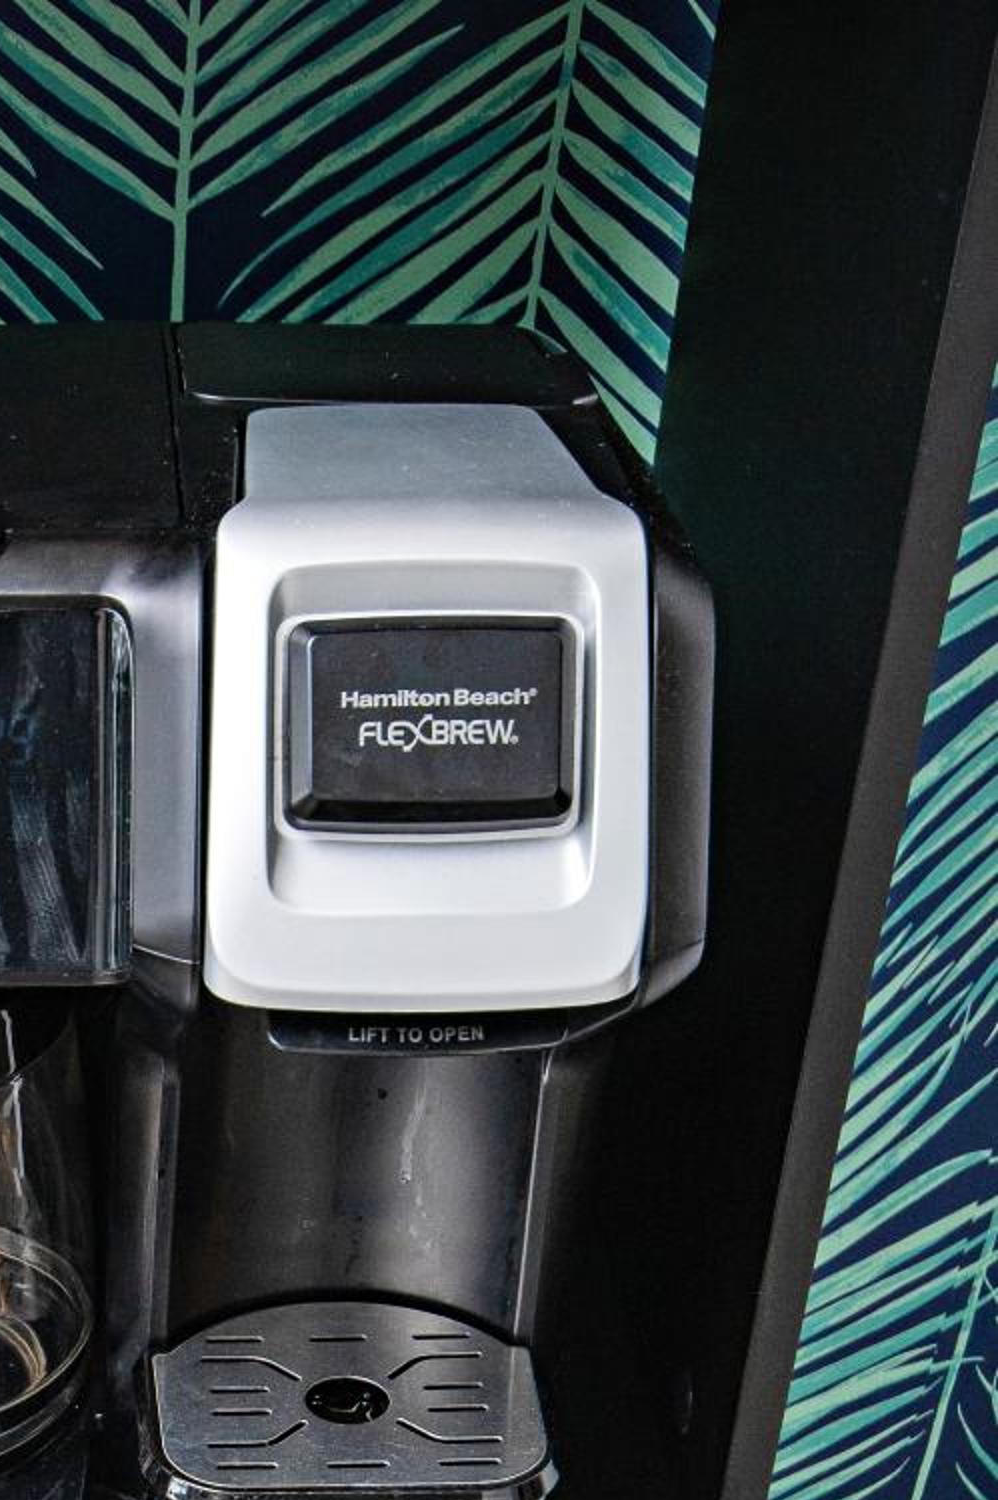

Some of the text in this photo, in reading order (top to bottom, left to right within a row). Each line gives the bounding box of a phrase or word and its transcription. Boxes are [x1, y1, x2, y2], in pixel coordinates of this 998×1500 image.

[340, 689, 450, 709] Hamilton
[348, 1025, 485, 1043] LIFT TO OPEN
